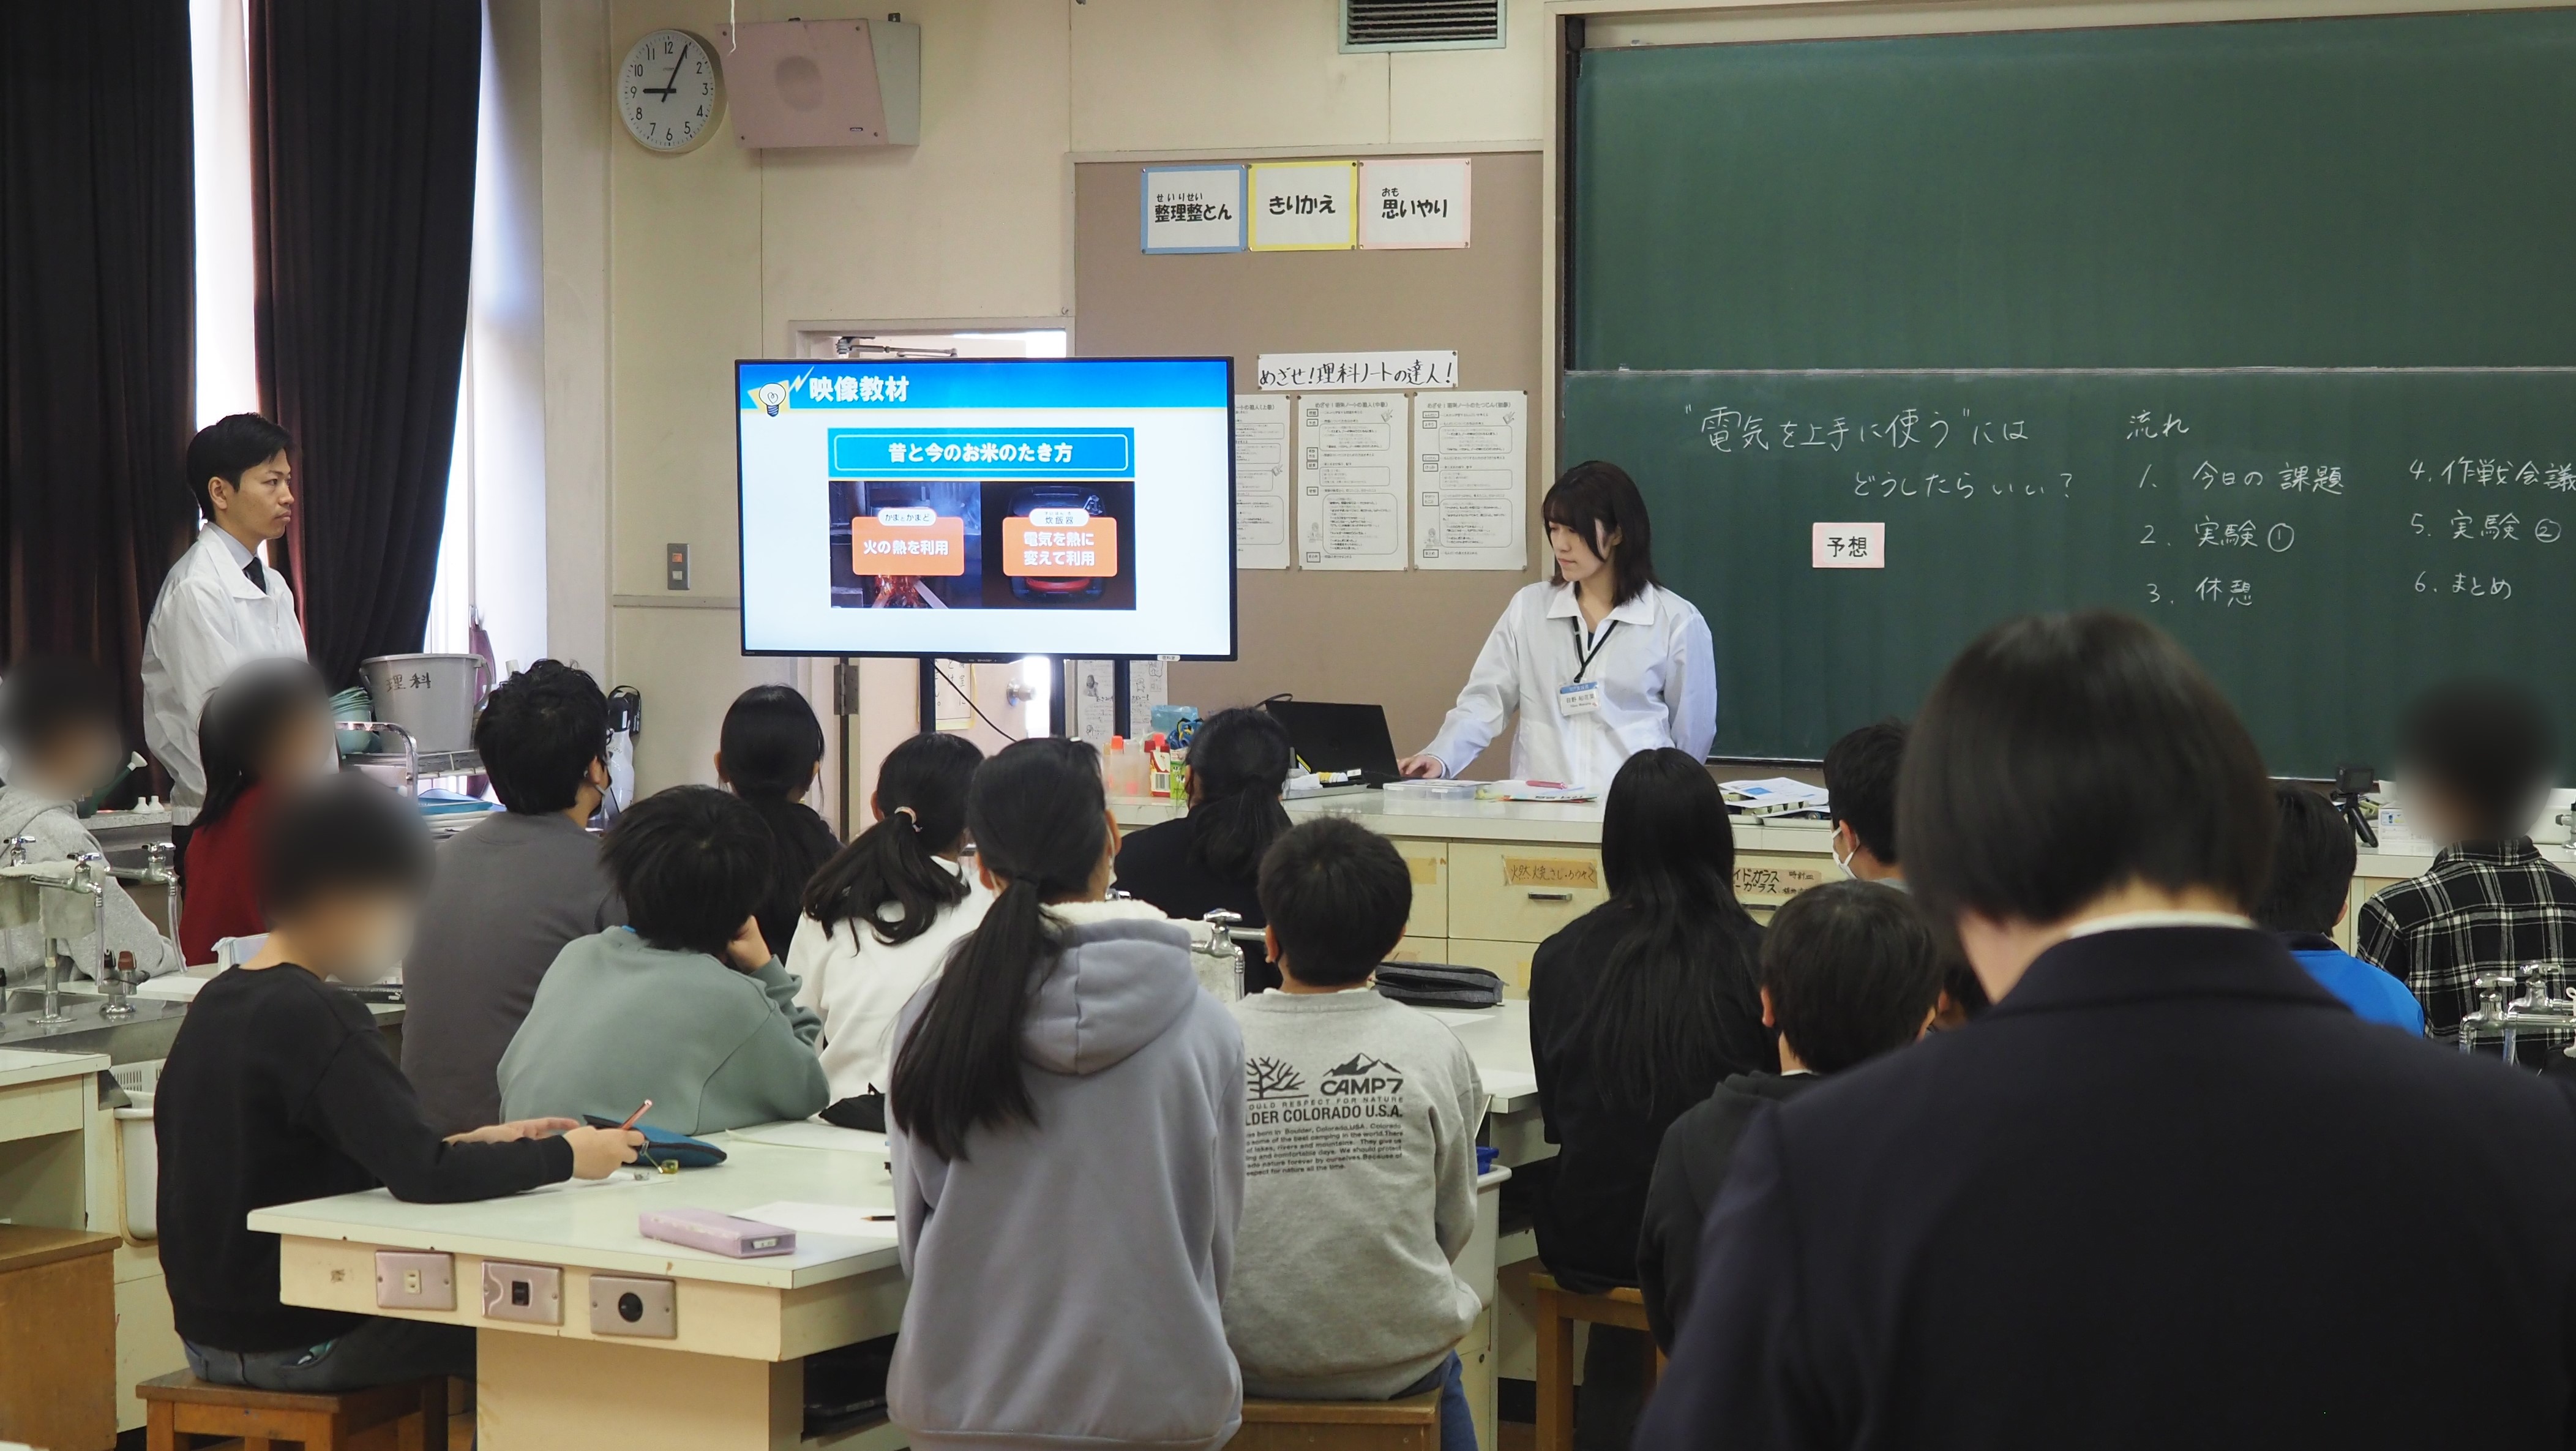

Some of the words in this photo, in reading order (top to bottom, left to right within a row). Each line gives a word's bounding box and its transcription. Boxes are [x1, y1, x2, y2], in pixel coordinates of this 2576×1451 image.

[648, 48, 655, 61] 11
[664, 42, 673, 54] 12
[634, 64, 643, 77] 10
[696, 62, 702, 74] 2
[631, 86, 637, 98] 9
[702, 83, 708, 96] 3
[635, 107, 642, 121] 8
[696, 105, 703, 117] 4
[650, 123, 656, 136] 7
[666, 128, 673, 141] 6
[684, 121, 691, 134] 5
[1381, 187, 1399, 197] おも
[1268, 194, 1336, 216] きりかえ
[1381, 199, 1448, 220] 思いやり
[1154, 203, 1233, 223] 整理整とん
[809, 375, 910, 404] 映像教材
[2126, 410, 2190, 440] 流れ
[888, 441, 1074, 465] 昔と今のお米のたき方
[1045, 516, 1074, 525] 炊飯器
[1023, 531, 1095, 547] 電気を熱に
[863, 539, 949, 556] 火の熱を利用
[1827, 536, 1868, 558] 予想
[1023, 550, 1095, 567] 変えて利用
[2195, 576, 2253, 607] 休憩
[2452, 571, 2512, 601] まとめ
[385, 672, 432, 692] 理科
[1282, 1098, 1330, 1108] RESPECT
[1283, 1105, 1361, 1123] COLORADO
[1366, 1104, 1403, 1117] U.S.A.
